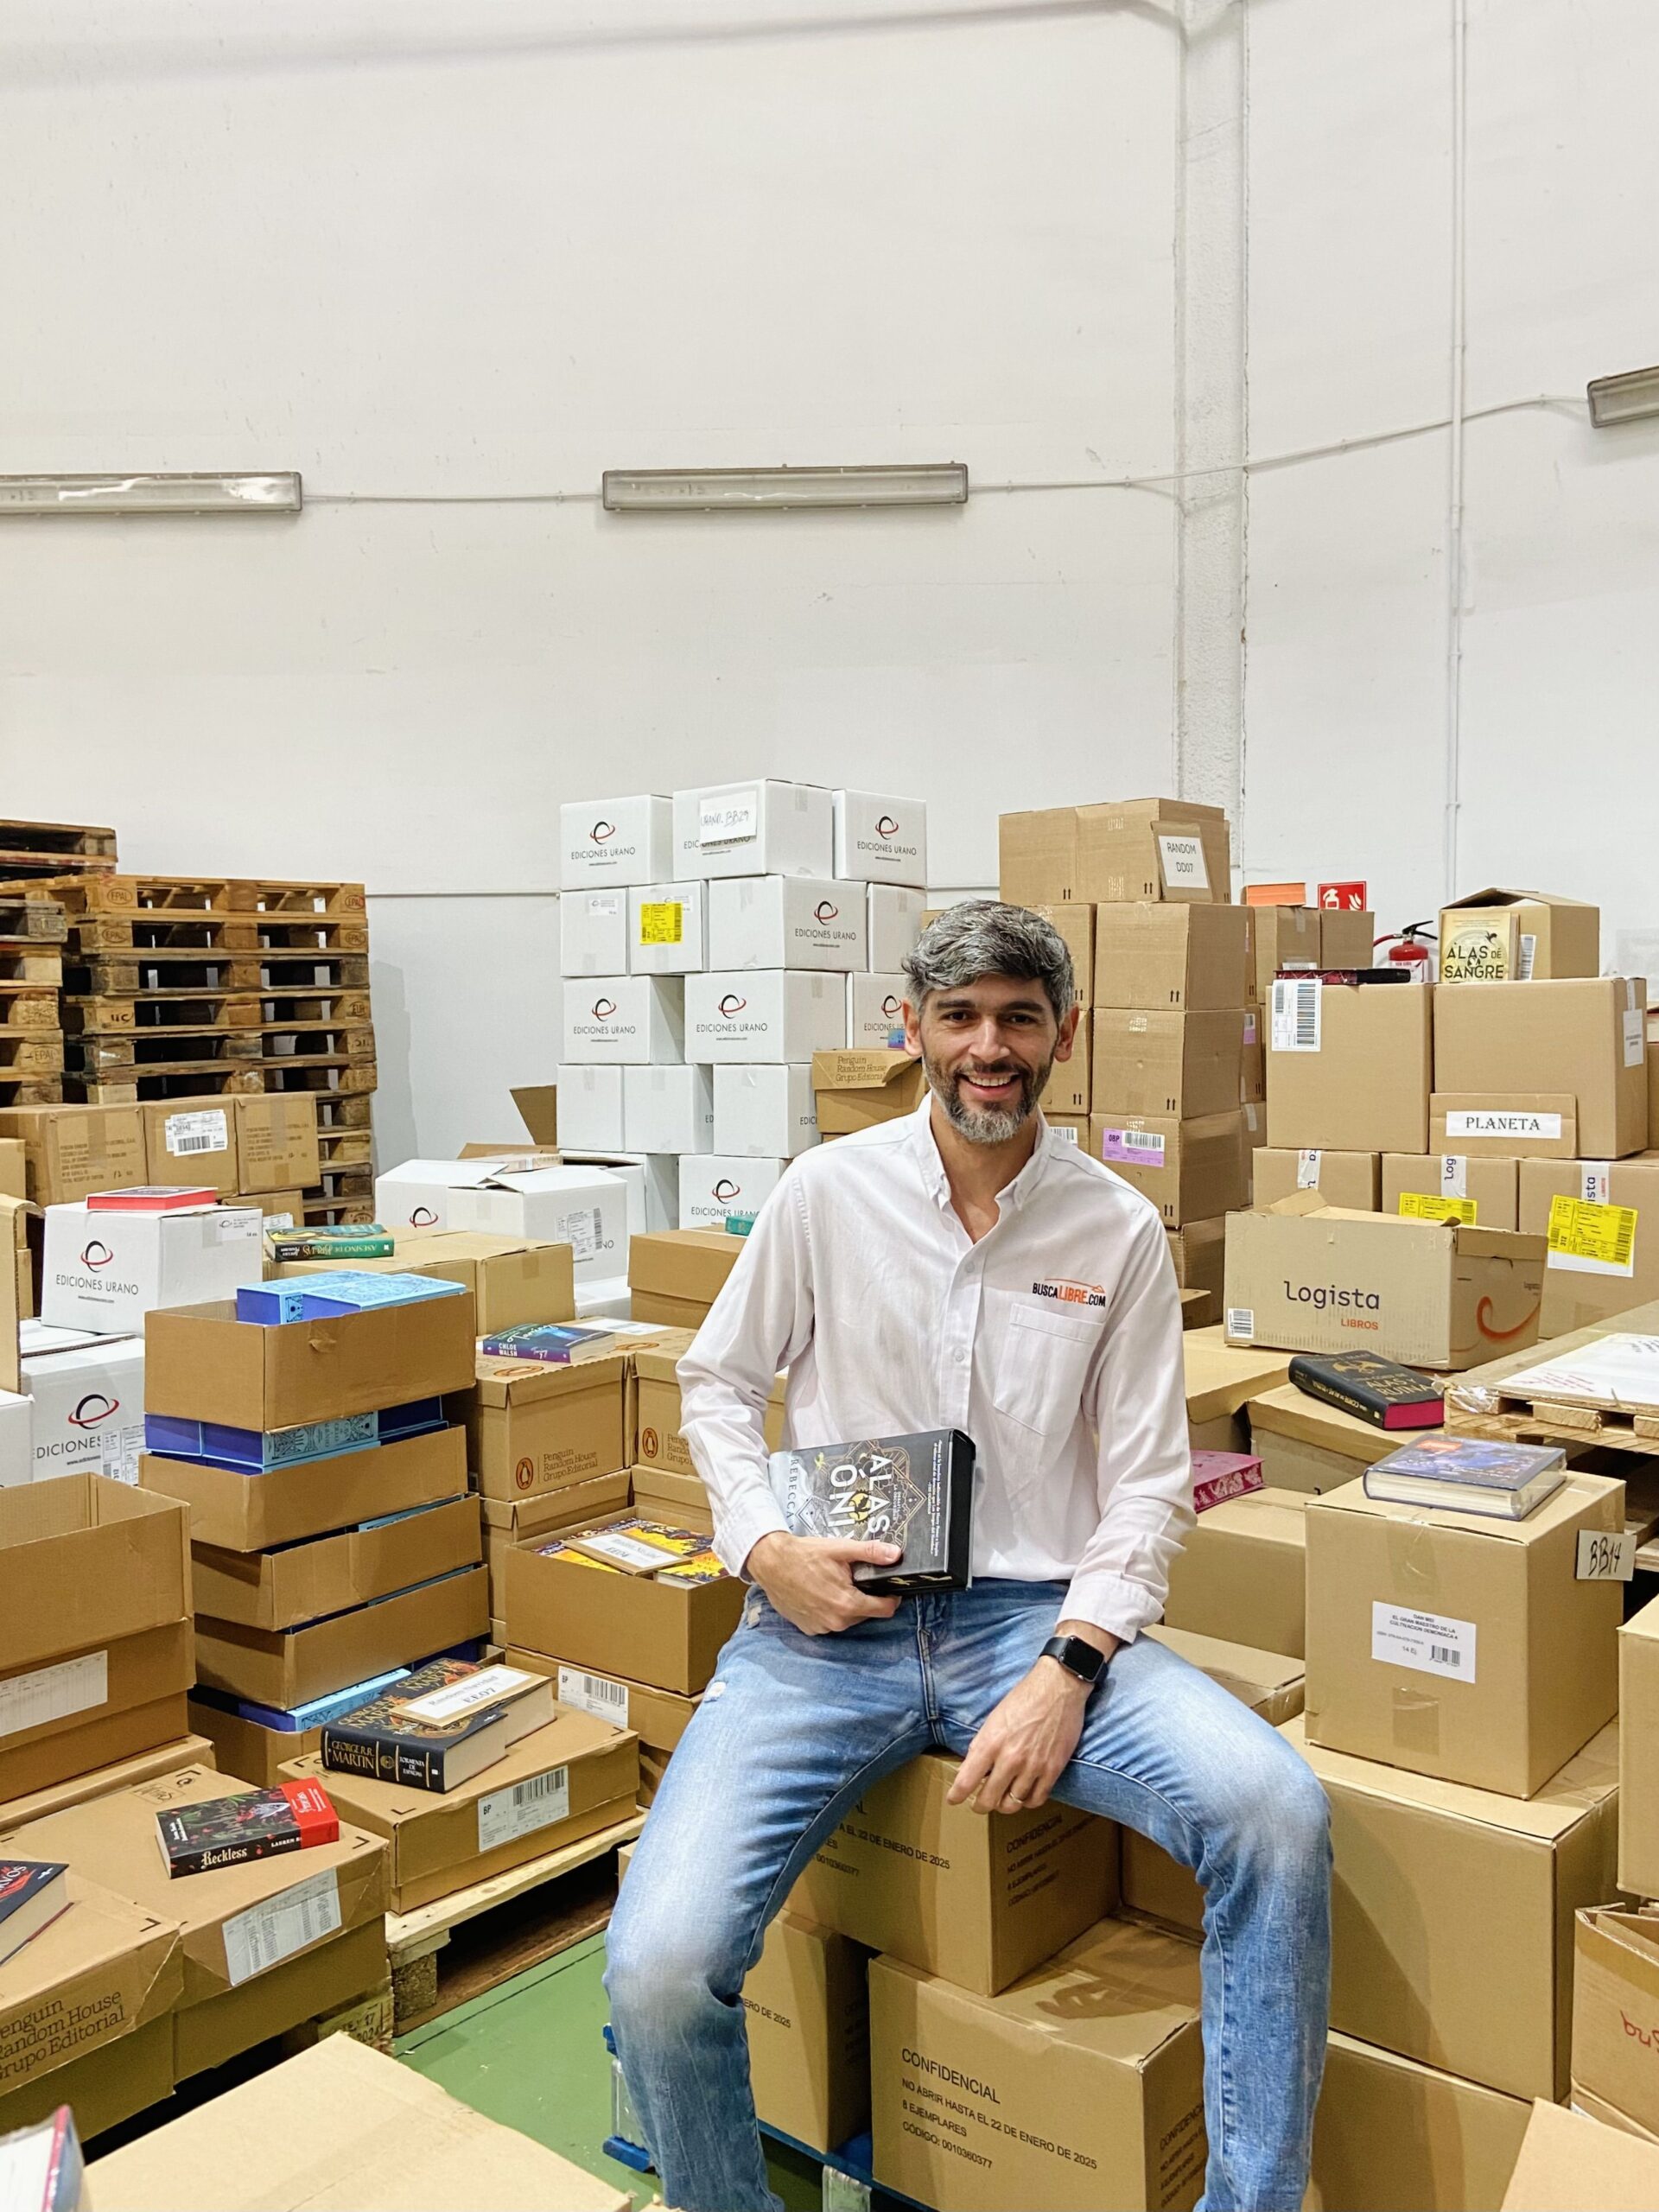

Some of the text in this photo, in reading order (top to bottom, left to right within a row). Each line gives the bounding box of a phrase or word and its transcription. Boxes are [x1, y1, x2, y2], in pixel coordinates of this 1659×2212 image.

[571, 847, 636, 860] EDICIONES URANO
[857, 841, 917, 855] EDICIONES URANO
[1166, 842, 1197, 856] RANDOM
[1175, 861, 1194, 874] DD07
[795, 928, 856, 941] EDICIONES URANO
[1446, 945, 1489, 959] ALAS
[1444, 964, 1504, 979] SANGRE
[573, 1026, 636, 1035] EDICIONES URANO
[696, 1023, 768, 1033] EDICIONES URANO
[837, 1056, 867, 1066] Penguin
[1465, 1116, 1541, 1131] PLANETA
[691, 1207, 732, 1217] EDICIONES
[56, 1274, 139, 1295] EDICIONES URANO
[1033, 1282, 1106, 1306] BUSCALIBRE.COM
[1283, 1281, 1380, 1311] logista
[1340, 1319, 1379, 1331] LIBROS
[1375, 1383, 1433, 1396] RUINA
[33, 1435, 101, 1459] DICIONES
[667, 1433, 689, 1447] Pengu
[667, 1443, 690, 1455] Rando
[543, 1448, 574, 1463] Penguin
[543, 1451, 598, 1472] Random House
[543, 1459, 598, 1482] Grupo Editorial
[786, 1458, 799, 1519] REBECCA
[868, 1454, 892, 1534] ALAS
[1588, 1535, 1622, 1577] BB14
[332, 1740, 360, 1755] GEORGE
[332, 1749, 375, 1770] MARTIN
[200, 1847, 248, 1870] Reckless
[869, 1834, 882, 1846] DE
[883, 1838, 914, 1857] ENERO
[915, 1850, 928, 1862] DE
[929, 1854, 950, 1870] 2025
[0, 1999, 64, 2039] enguin
[67, 1991, 122, 2027] House
[761, 2006, 772, 2019] DE
[773, 2012, 791, 2029] 2025
[48, 2005, 126, 2056] Editorial
[902, 2048, 1001, 2105] CONFIDENCIAL
[901, 2078, 1097, 2170] NO ABRIR HASTA EL 22 DE ENERO DE 2025
[902, 2100, 968, 2137] 8 EJEMPLARES
[903, 2120, 941, 2146] CÓDIGO:
